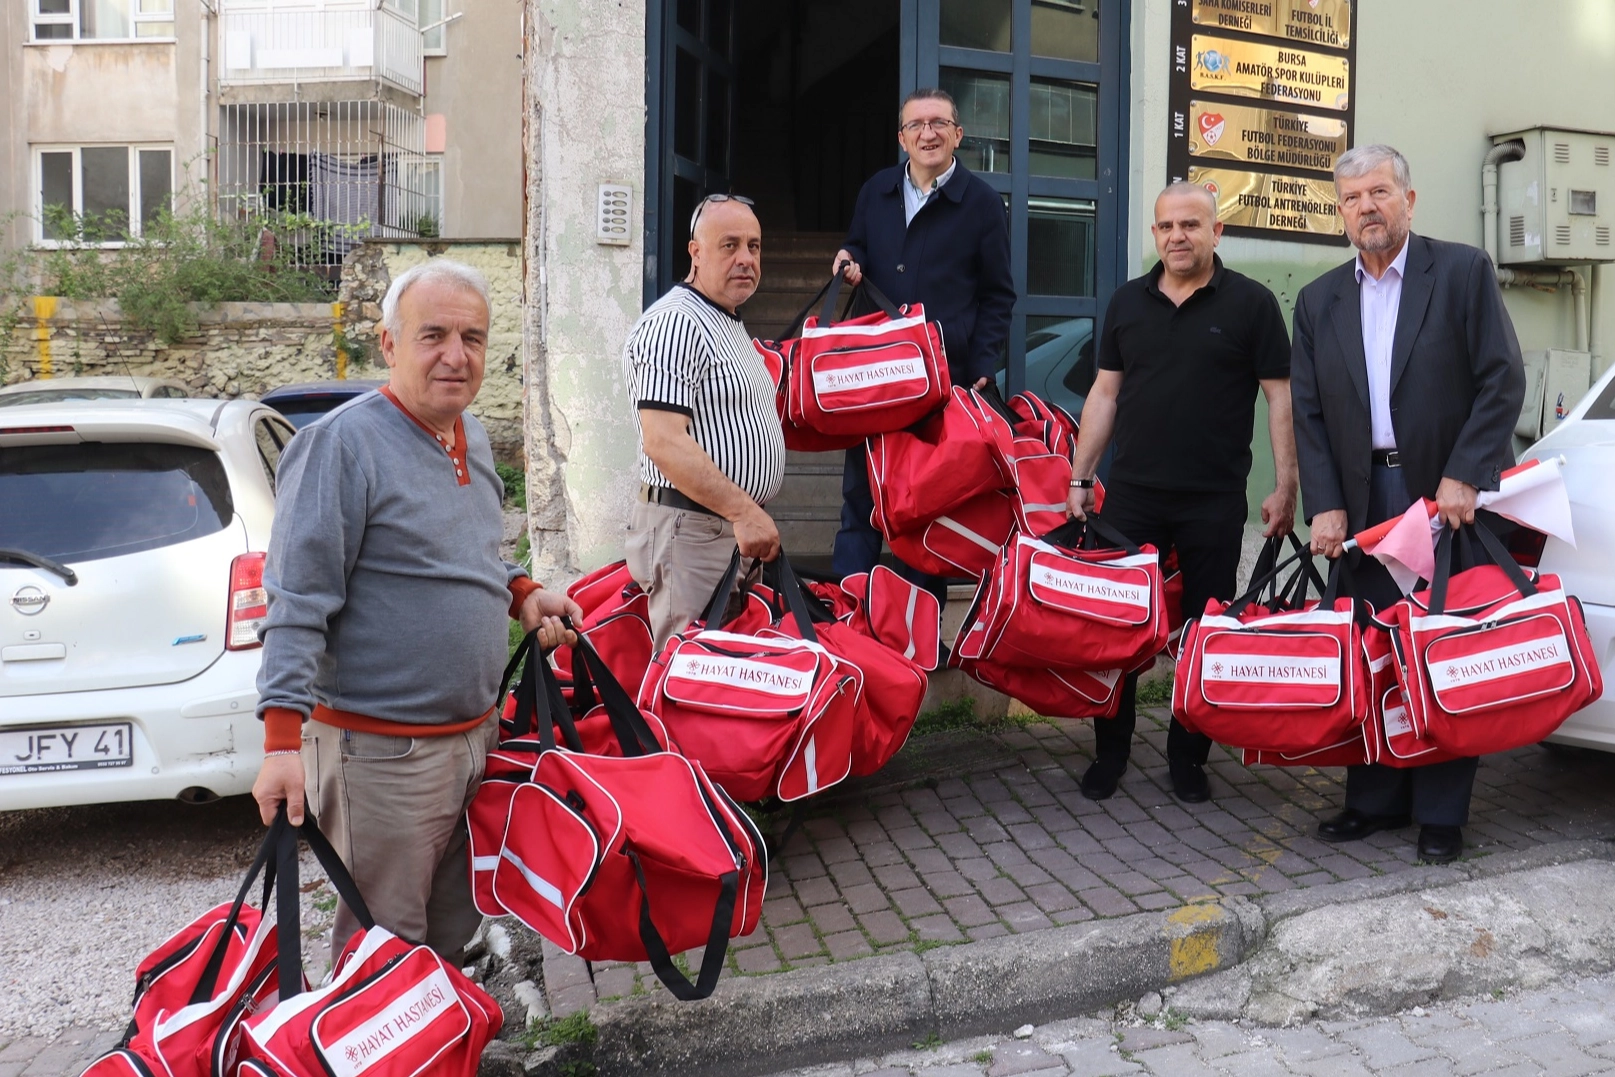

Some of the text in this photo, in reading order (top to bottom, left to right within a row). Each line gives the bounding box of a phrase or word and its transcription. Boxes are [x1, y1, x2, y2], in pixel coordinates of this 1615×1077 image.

[1218, 13, 1252, 30] DERNEĞİ
[1291, 10, 1333, 29] FUTBOL İL
[1285, 24, 1339, 45] TEMSİLCİLİĞİ
[1176, 45, 1186, 73] 2 KAT
[1278, 51, 1306, 67] BURSA
[1235, 62, 1345, 89] AMATÖR SPOR KULÜPLERİ
[1261, 81, 1321, 102] FEDERASYONU
[1174, 111, 1185, 131] KAT
[1273, 115, 1309, 133] TÜRKİYE
[1242, 129, 1336, 153] FUTBOL FEDERASYONU
[1247, 145, 1331, 169] BÖLGE MÜDÜRLÜĞÜ
[1272, 178, 1307, 196] TÜRKİYE
[1238, 194, 1336, 216] FUTBOL ANTRENÖRLERİ
[1269, 213, 1307, 229] DERNEĞİ
[837, 362, 915, 384] HAYAT HASTANESİ
[1055, 577, 1140, 600] HAYAT HASTANESİ
[1460, 643, 1559, 678] HAYAT HASTANESİ
[700, 664, 803, 689] HAYAT HASTANESİ
[1231, 665, 1327, 679] HAYAT HASTANESİ
[14, 729, 123, 762] JFY 41
[357, 984, 446, 1059] HAYAT HASTANESİ
